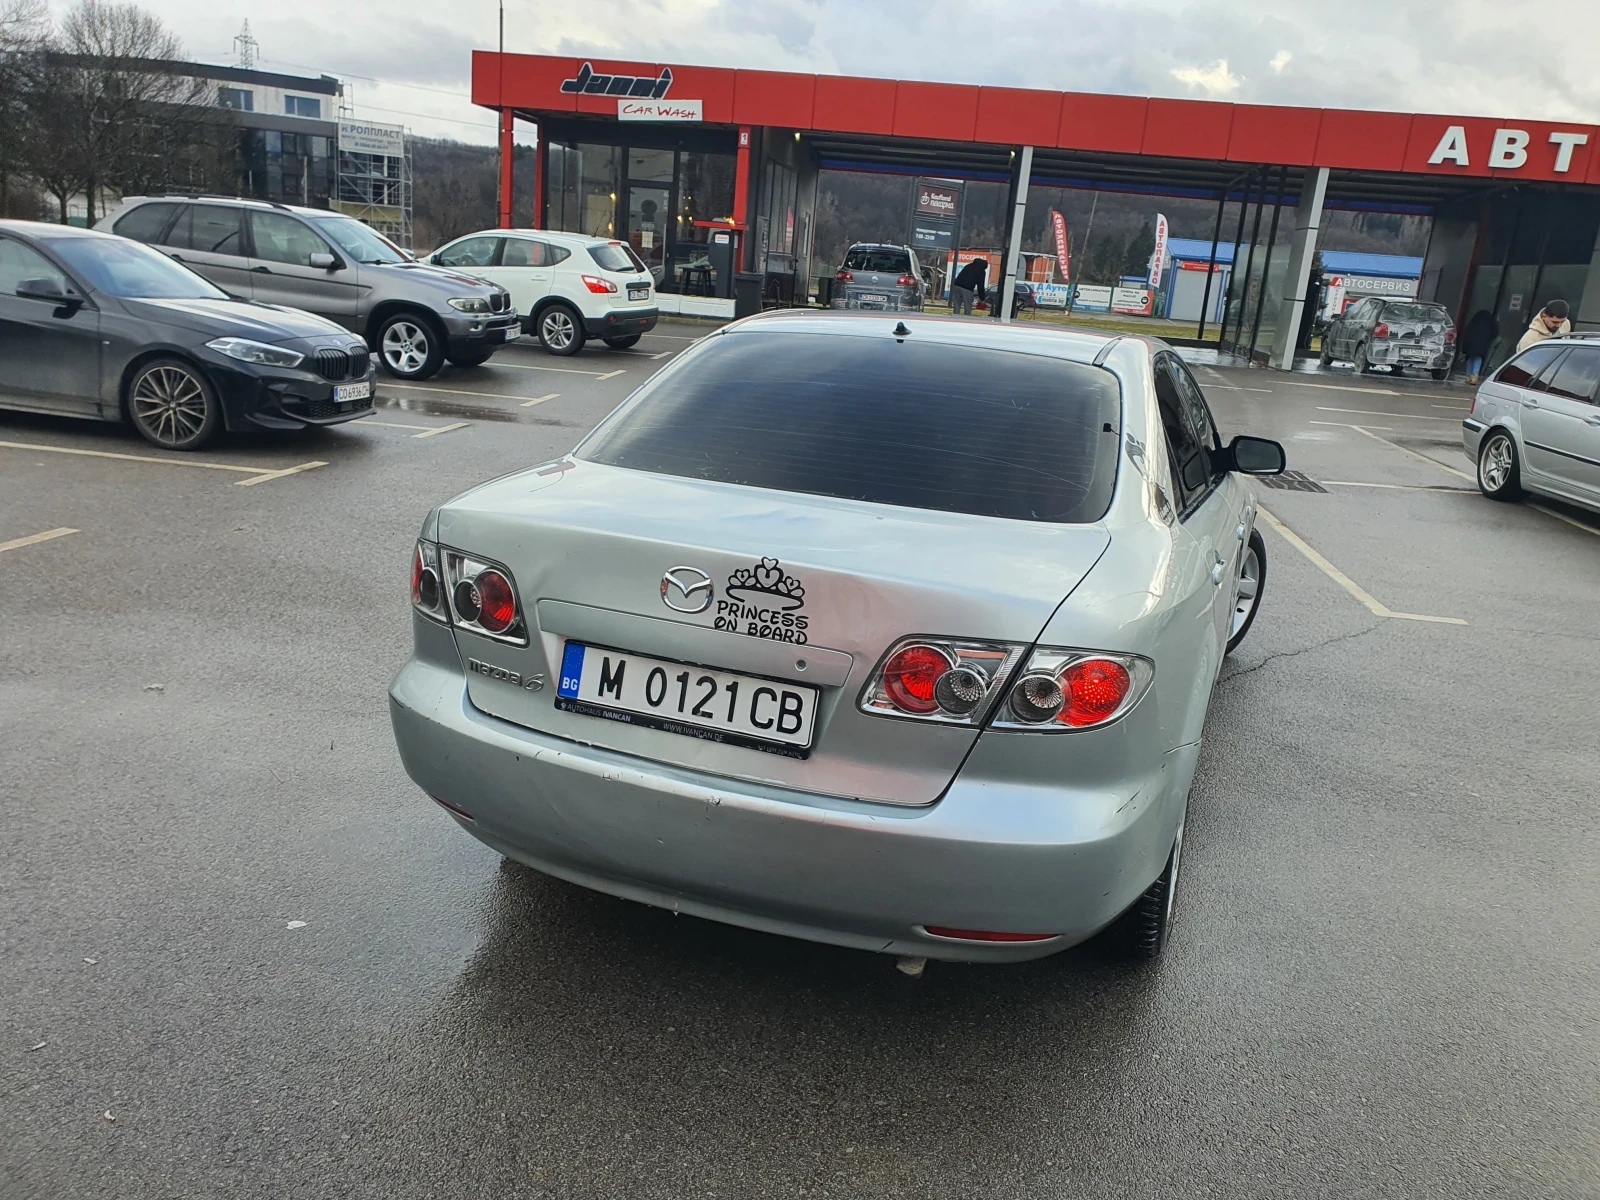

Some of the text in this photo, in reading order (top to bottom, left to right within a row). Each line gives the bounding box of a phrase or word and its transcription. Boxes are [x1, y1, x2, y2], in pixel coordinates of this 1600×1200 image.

[622, 103, 697, 119] CAR WASH
[350, 125, 400, 138] РОЛПЛАСТ
[1427, 125, 1589, 173] АВТ
[1335, 278, 1410, 291] АВТОСЕРВИЗ
[717, 600, 809, 630] PRINCESS
[714, 616, 808, 645] ON BOARD
[562, 676, 579, 691] BG
[598, 656, 627, 700] M
[567, 704, 632, 722] AUTOHAUS IVANCAN
[662, 722, 725, 742] WWW.IVANCAN.DE
